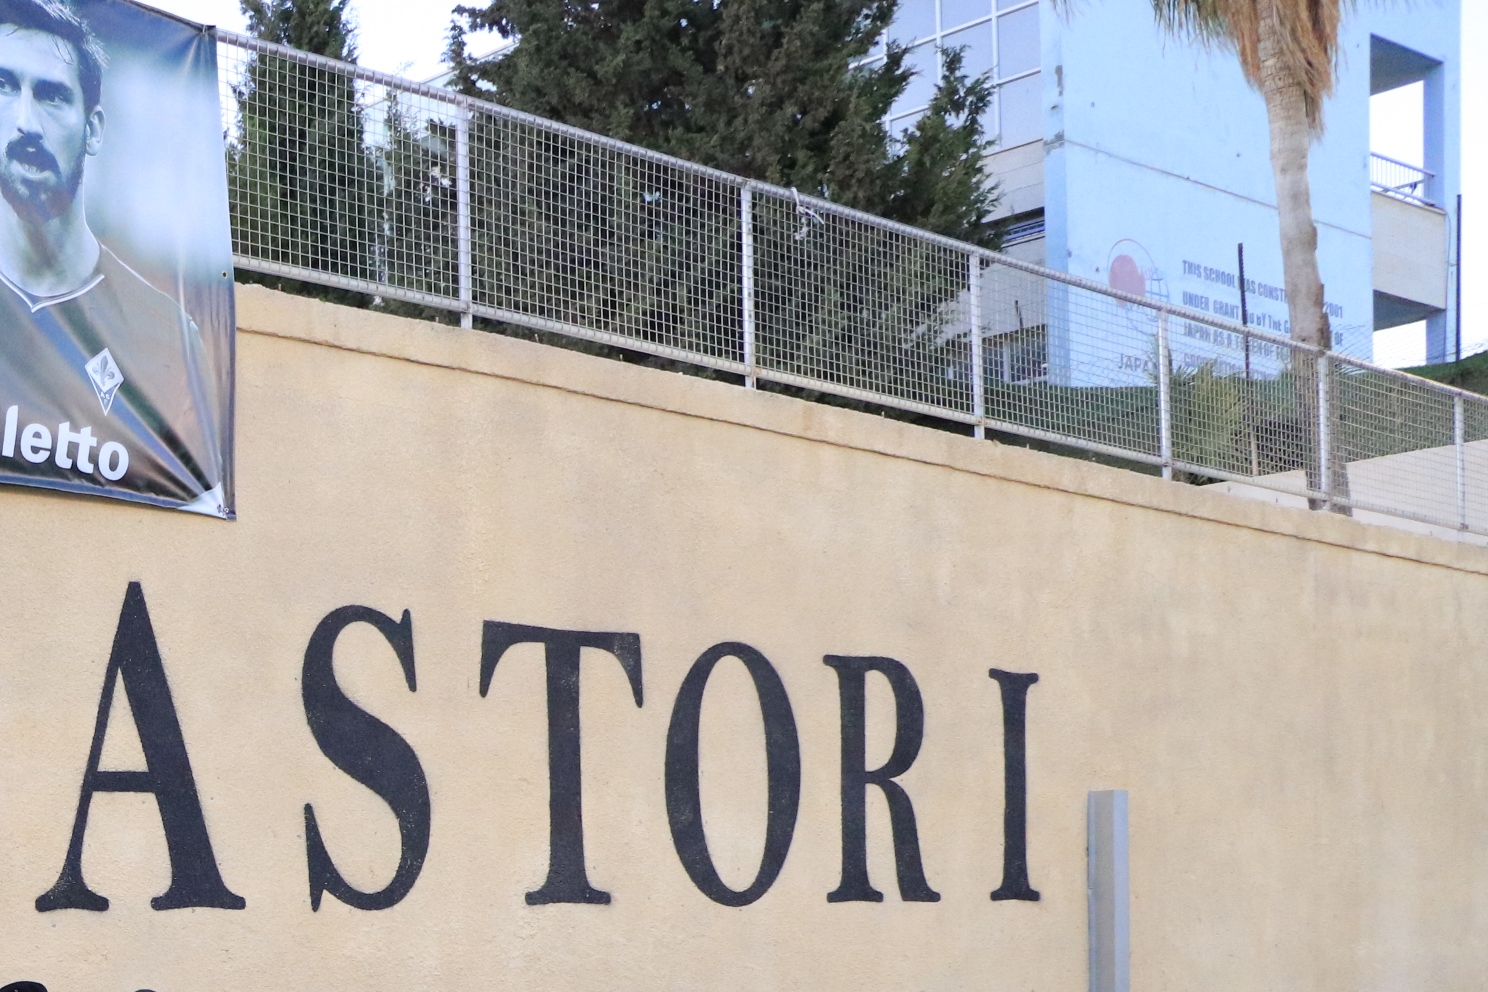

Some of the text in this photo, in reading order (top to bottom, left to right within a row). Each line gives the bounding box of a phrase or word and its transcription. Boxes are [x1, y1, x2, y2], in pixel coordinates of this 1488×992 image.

[1182, 259, 1202, 278] THIS
[1203, 266, 1236, 288] SCHOOL
[1182, 290, 1210, 312] UNDER
[1213, 299, 1239, 320] GRANT
[35, 580, 1040, 913] ASTORI
